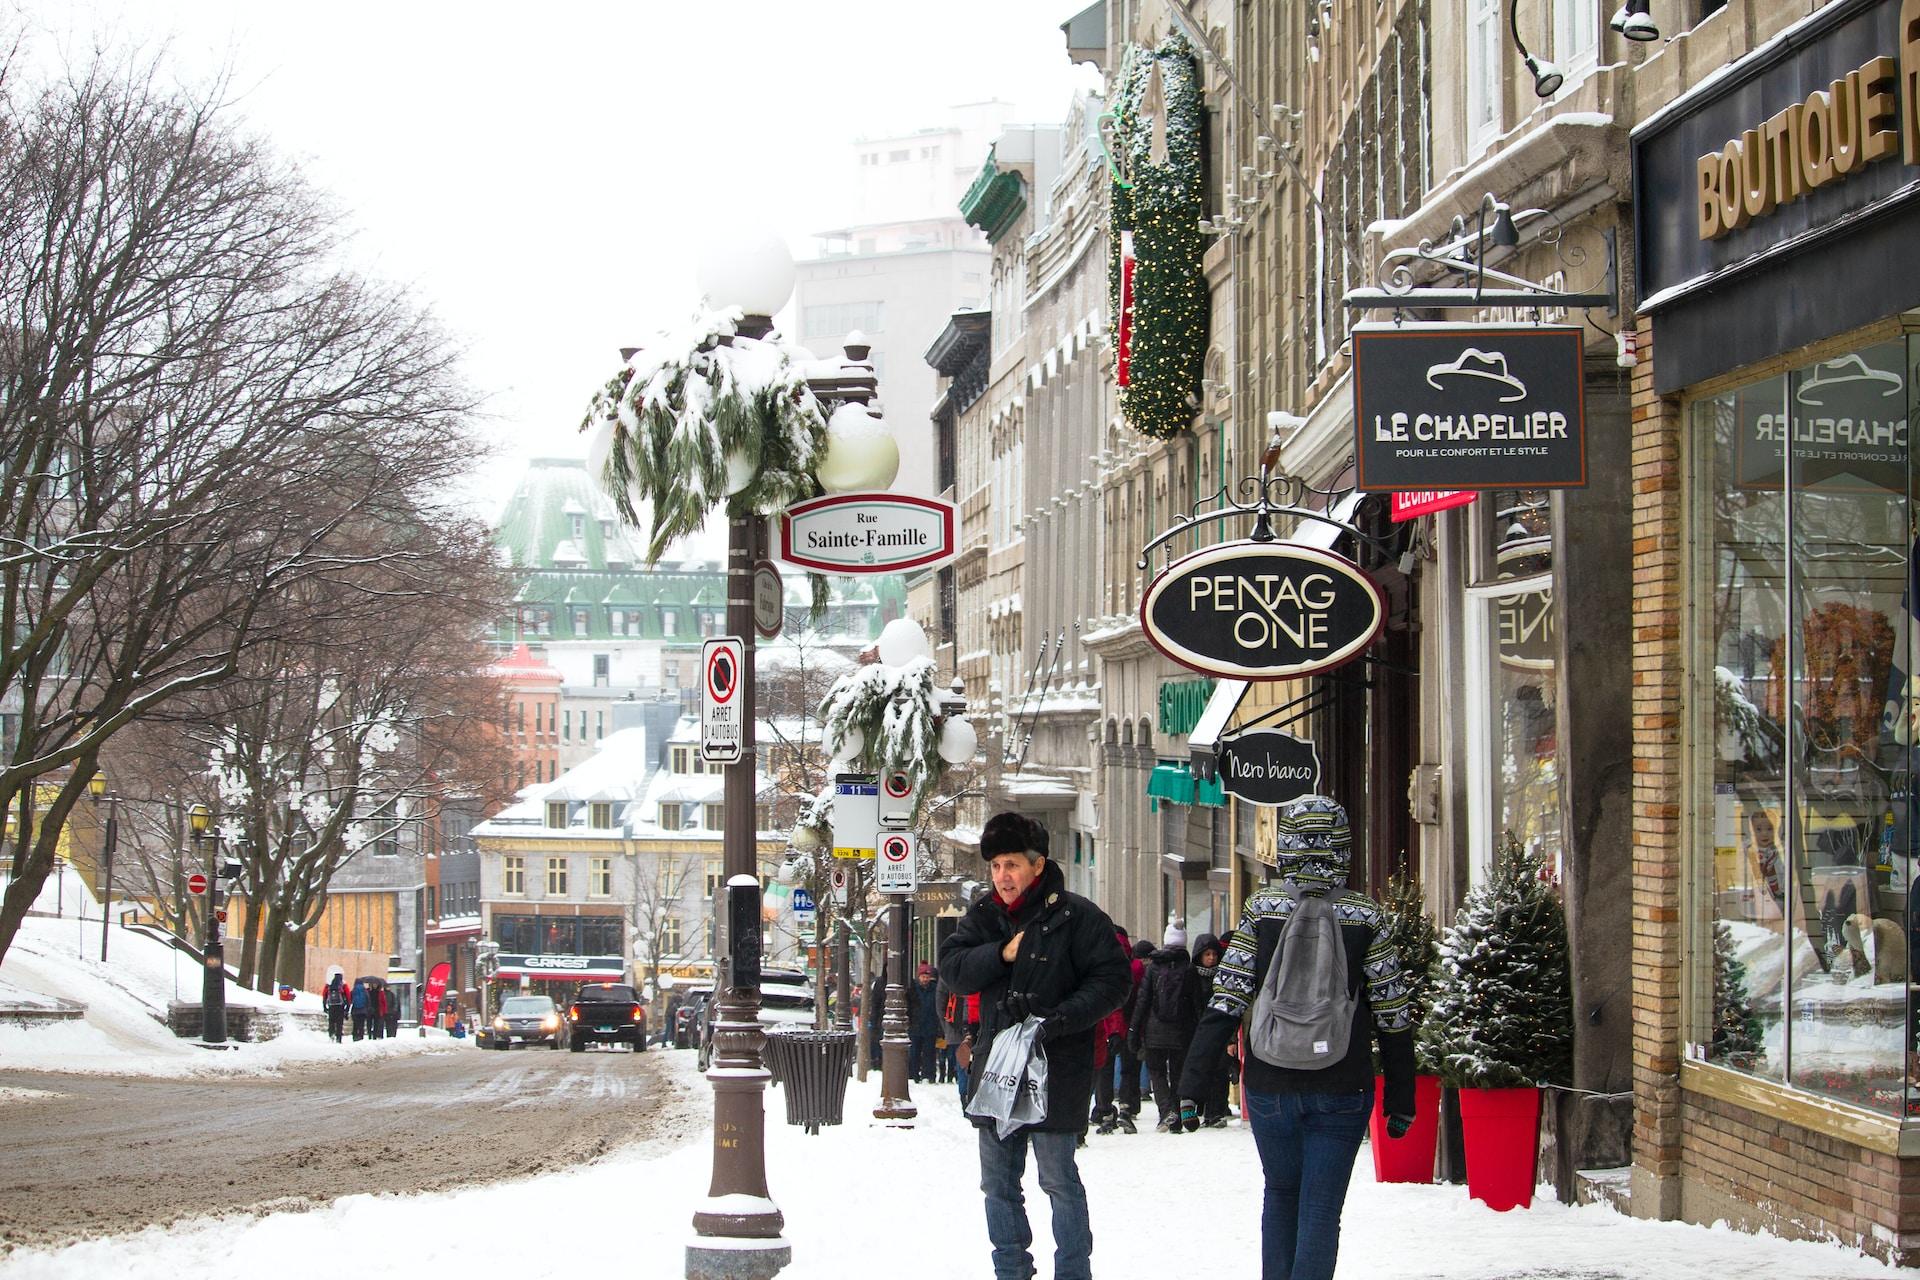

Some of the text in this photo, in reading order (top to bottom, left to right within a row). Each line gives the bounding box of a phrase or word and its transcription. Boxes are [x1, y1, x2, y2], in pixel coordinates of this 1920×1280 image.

[1697, 56, 1898, 241] BOUTIQUE
[1375, 411, 1568, 441] LE CHAPELIER
[1396, 446, 1549, 458] POUR LE CONFORT ET LE STYLE
[857, 512, 878, 523] Rue
[807, 528, 928, 549] Sainte-Famille
[1190, 573, 1336, 611] PENTAG
[1233, 611, 1329, 649] ONE
[1226, 749, 1312, 780] Nero bianco
[850, 785, 861, 794] 11
